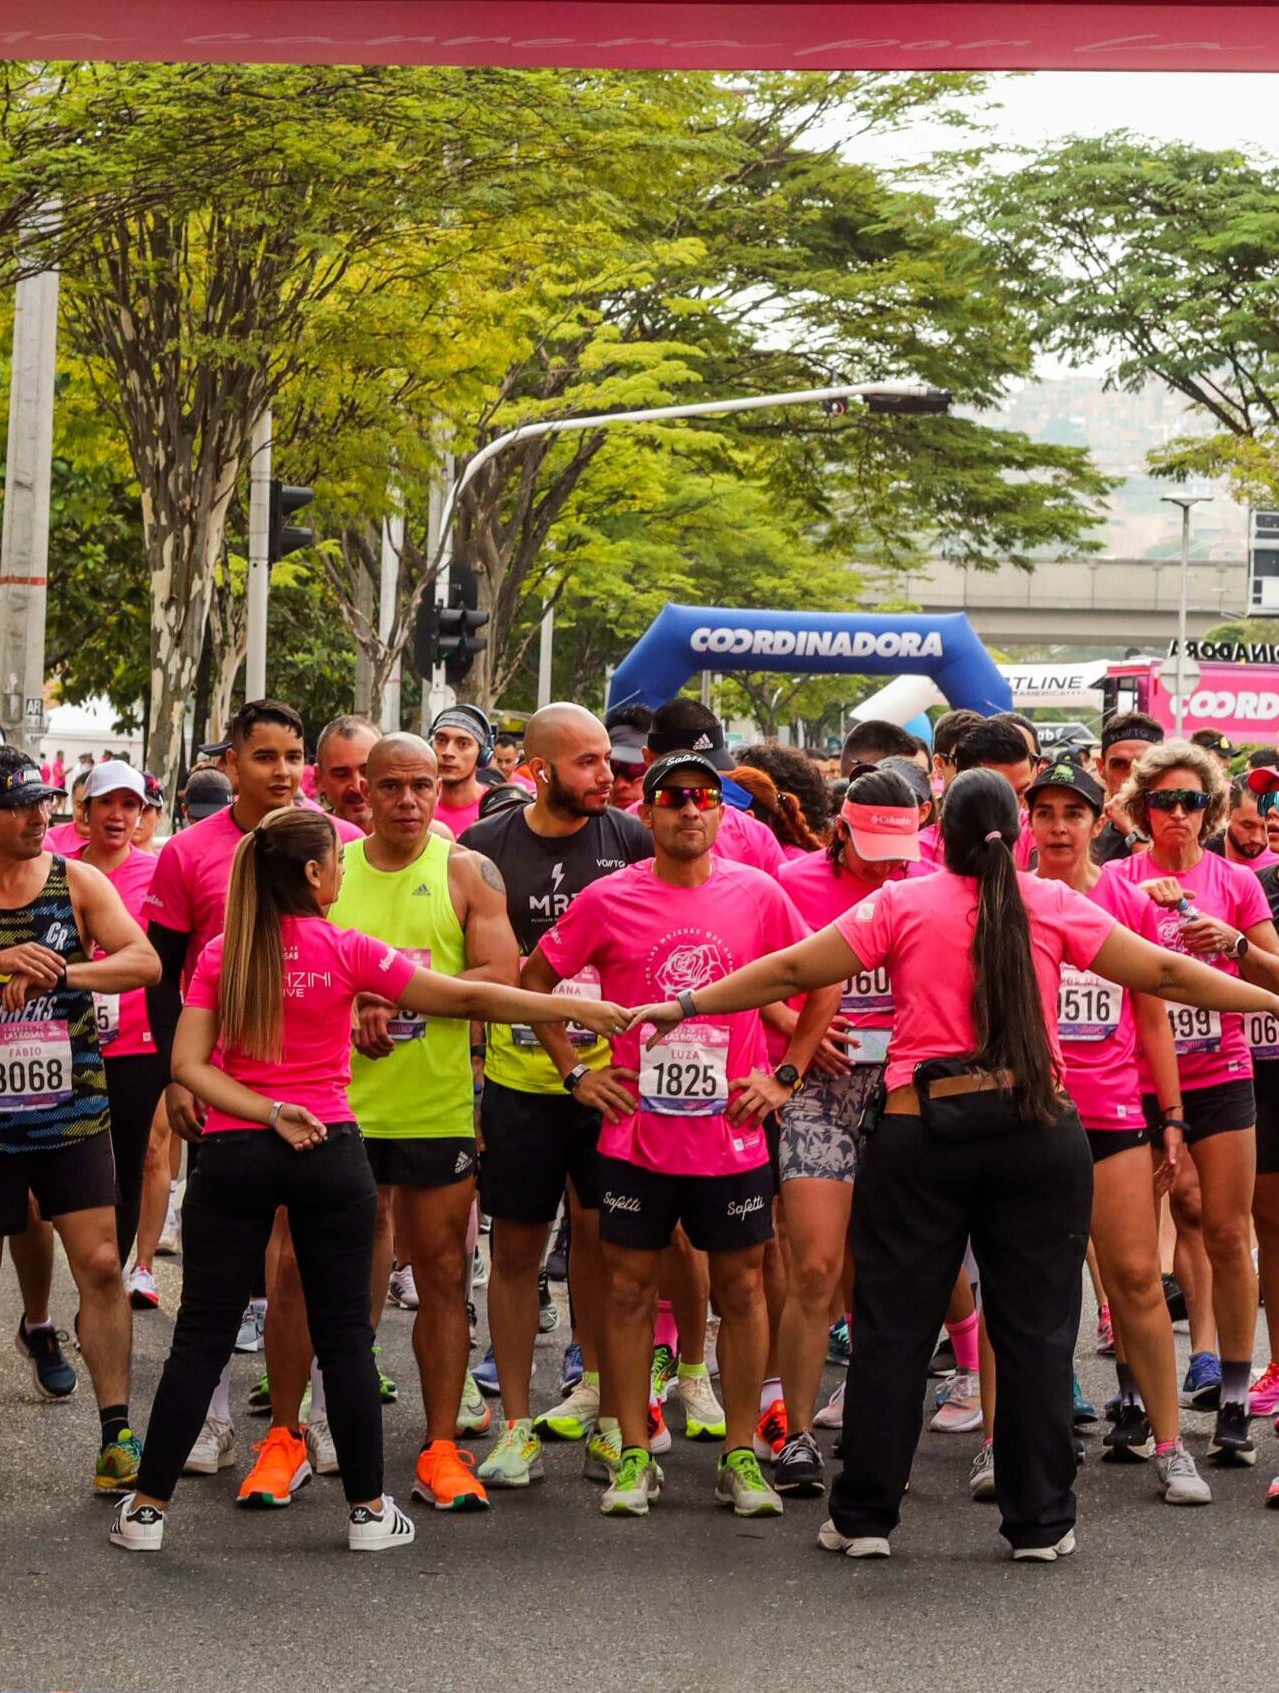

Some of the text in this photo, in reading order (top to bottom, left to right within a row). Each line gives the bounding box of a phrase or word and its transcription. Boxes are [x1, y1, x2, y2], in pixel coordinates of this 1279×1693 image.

[690, 627, 943, 658] COORDINADORA
[46, 922, 68, 950] CR
[9, 1047, 41, 1058] FABIO
[672, 1051, 699, 1060] LUZA
[653, 1062, 717, 1097] 1825
[727, 1195, 766, 1222] Safetti
